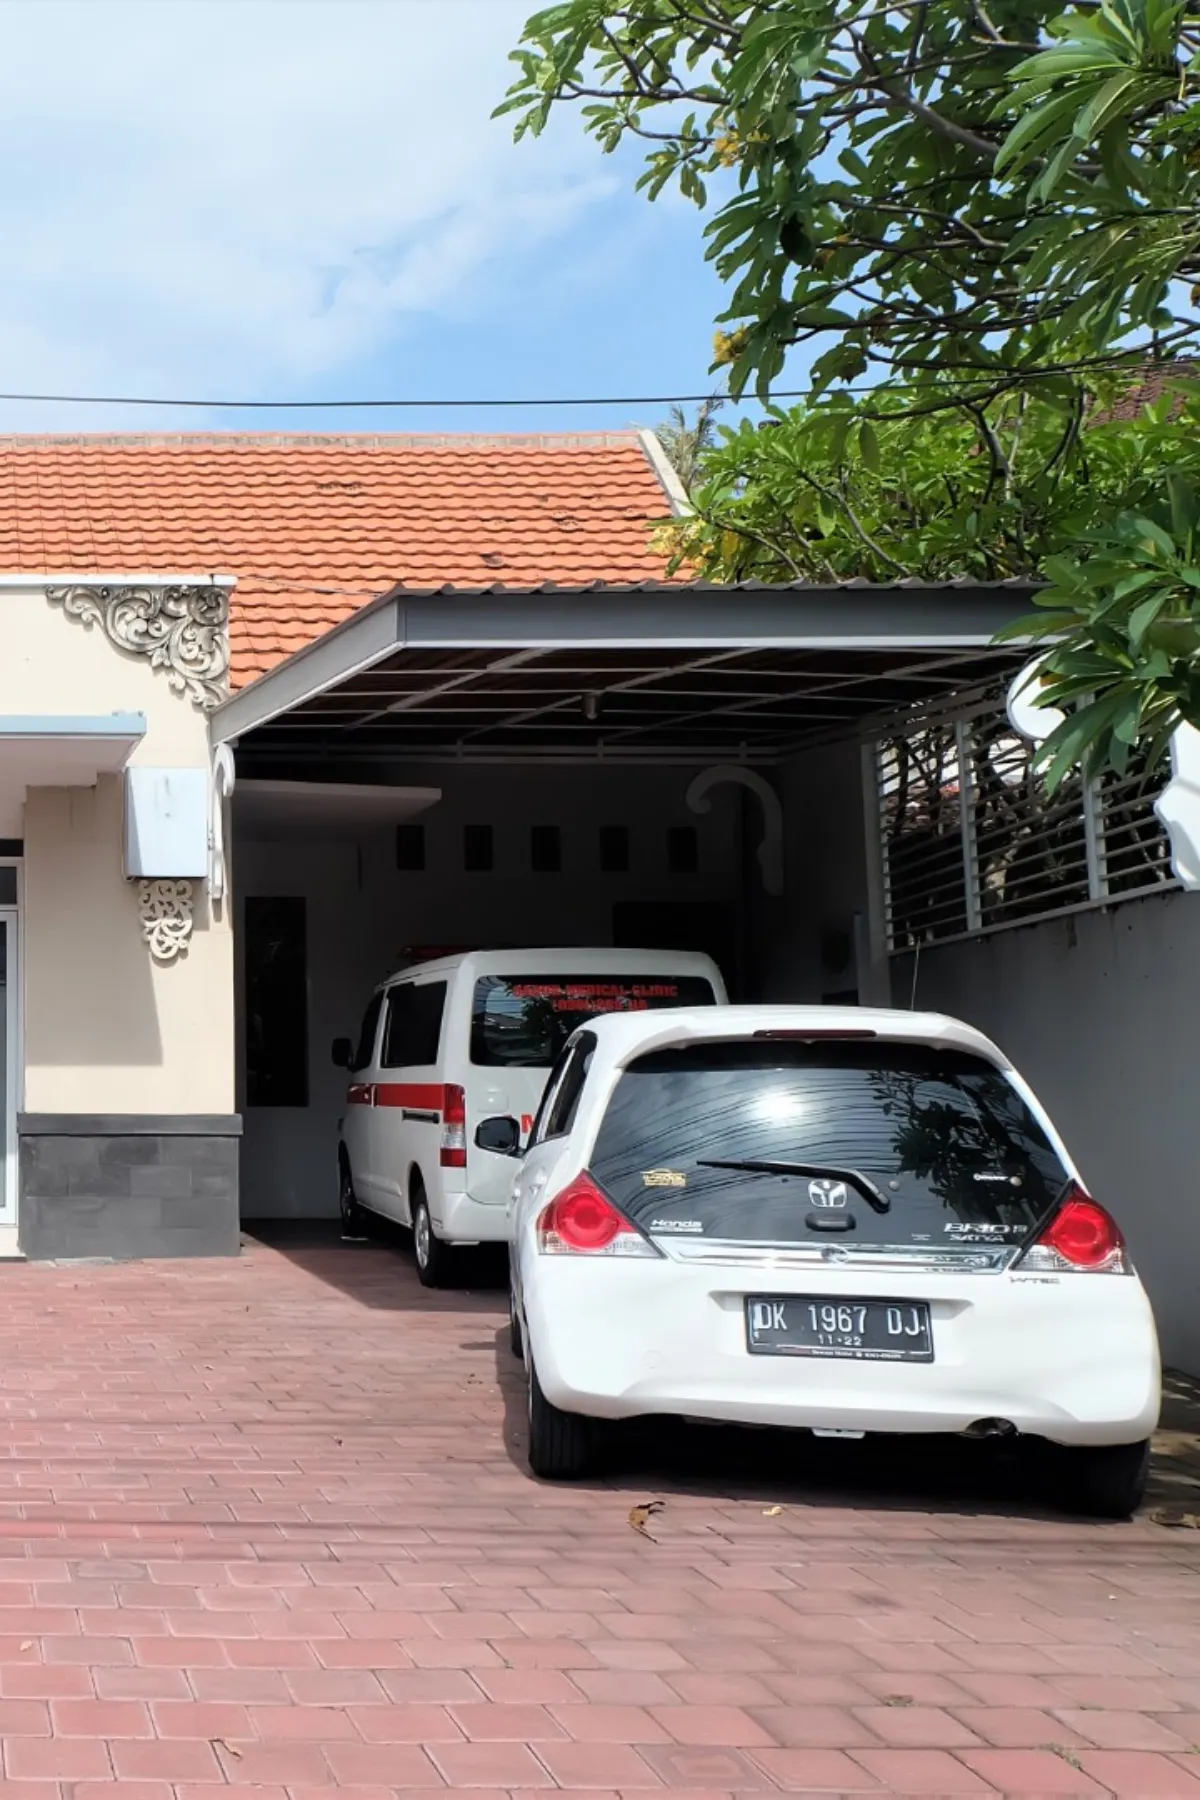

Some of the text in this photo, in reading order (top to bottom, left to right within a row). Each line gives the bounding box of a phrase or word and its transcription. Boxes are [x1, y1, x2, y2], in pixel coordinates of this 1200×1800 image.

[565, 984, 627, 997] MEDICAL
[631, 984, 679, 997] CLINIC
[651, 1219, 702, 1227] Honda
[943, 1222, 1010, 1233] BRIO
[755, 1302, 921, 1336] DK 1967 DJ
